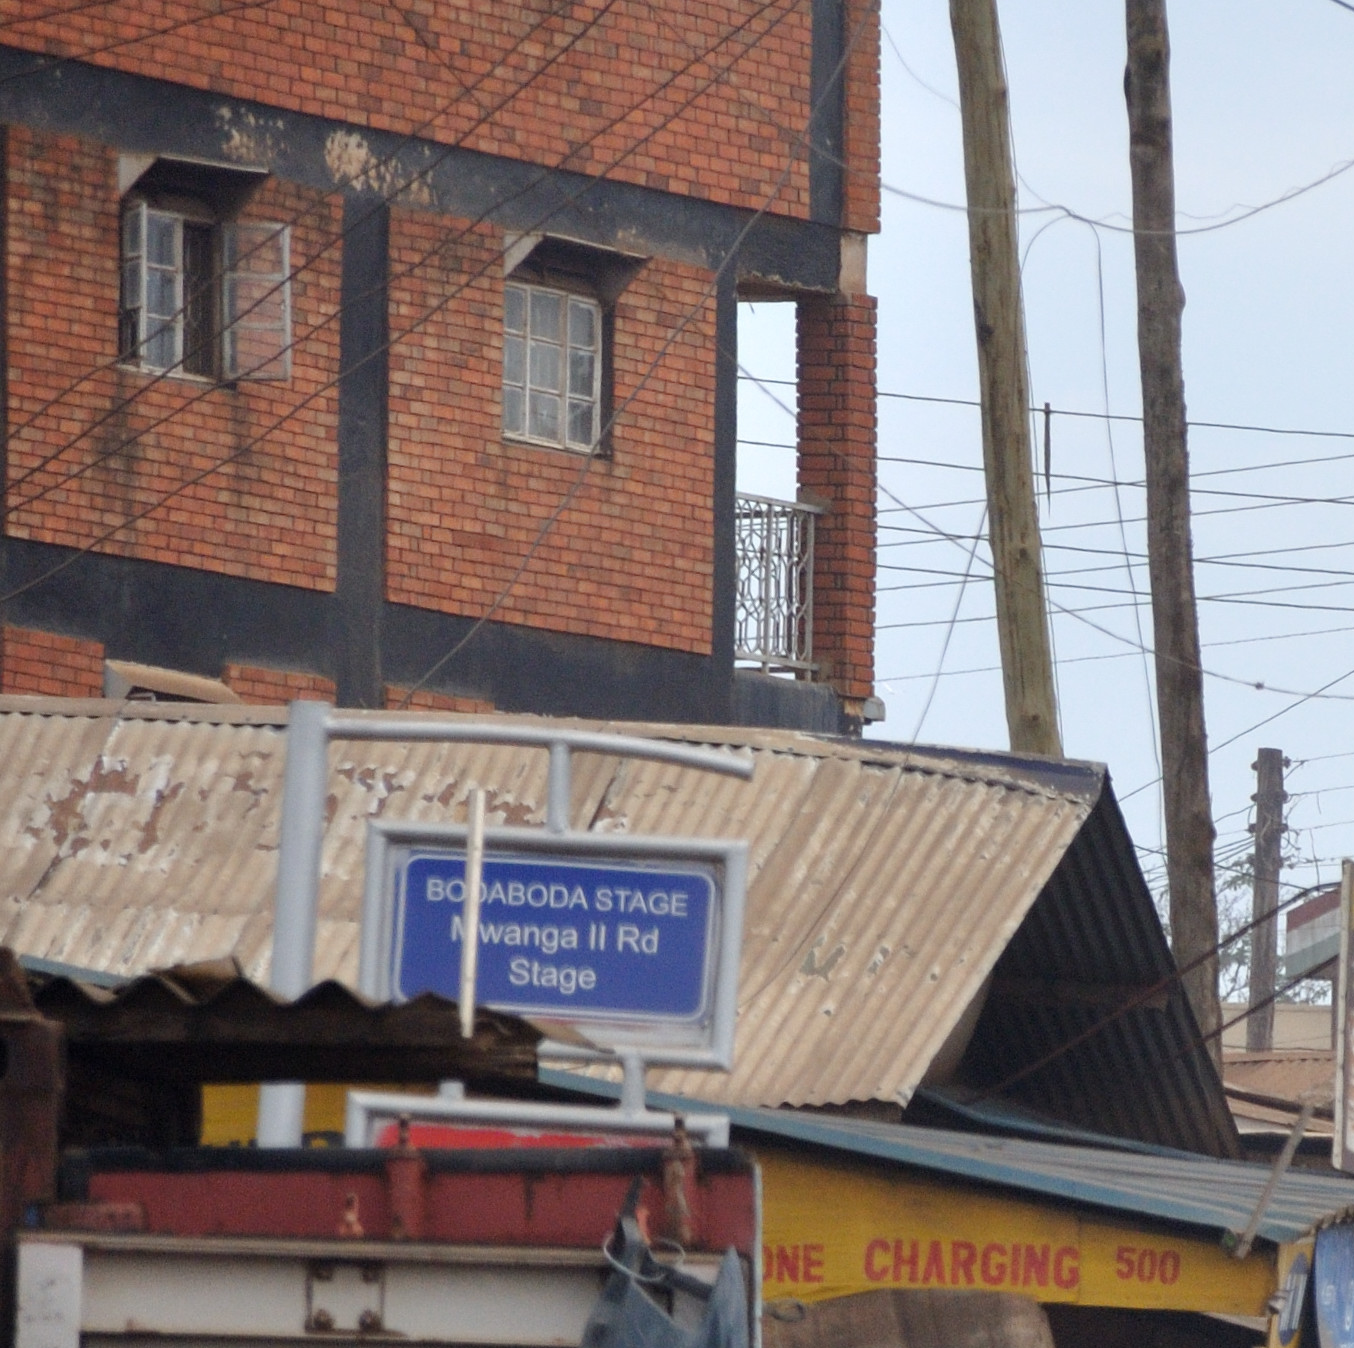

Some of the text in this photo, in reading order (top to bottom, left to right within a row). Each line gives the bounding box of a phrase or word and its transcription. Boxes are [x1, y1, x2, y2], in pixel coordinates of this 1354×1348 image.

[595, 888, 688, 917] STAGE
[618, 925, 659, 954] Rd
[509, 957, 597, 995] Stage
[863, 1238, 1080, 1289] CHARGING
[1116, 1245, 1181, 1285] 500
